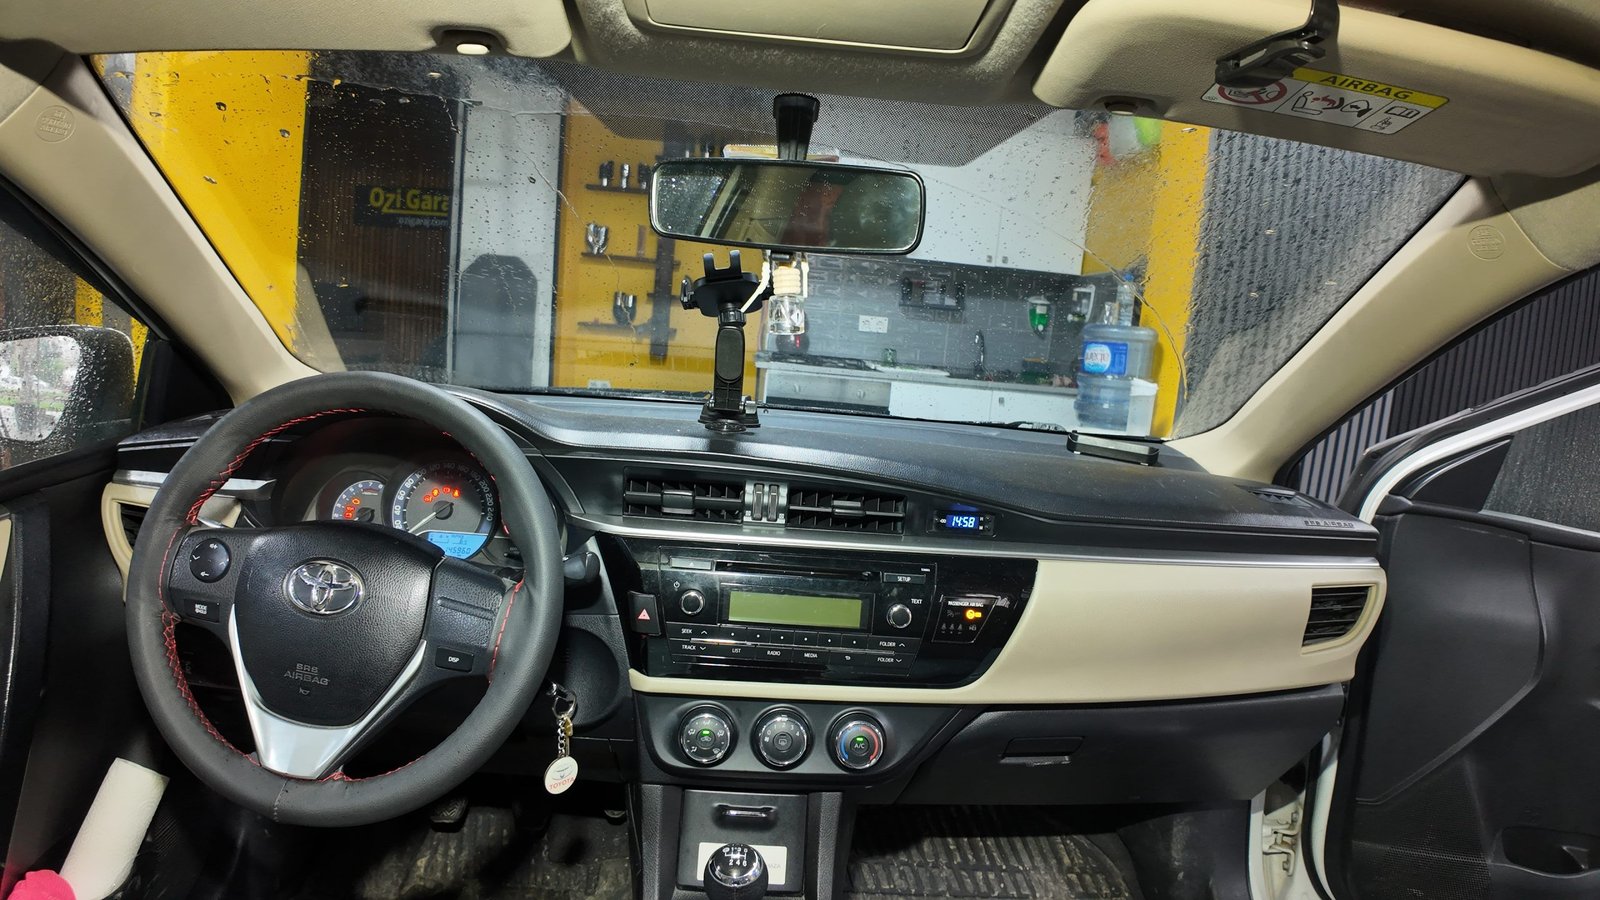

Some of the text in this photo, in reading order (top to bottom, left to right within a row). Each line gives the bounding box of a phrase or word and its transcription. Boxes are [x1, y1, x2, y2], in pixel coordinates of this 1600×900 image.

[1319, 74, 1413, 101] AIRBAG
[370, 187, 402, 214] Ozi
[405, 478, 415, 489] 80
[479, 480, 490, 493] 200
[397, 490, 406, 501] 60
[486, 493, 494, 507] 220
[394, 505, 401, 516] 40
[487, 507, 495, 521] 240
[951, 515, 976, 528] 14:58
[1323, 521, 1355, 529] AIRBAG
[947, 600, 970, 608] PASSENGER
[296, 663, 319, 673] SRS
[283, 670, 330, 686] AIRBAG
[549, 777, 575, 790] TOYOTA
